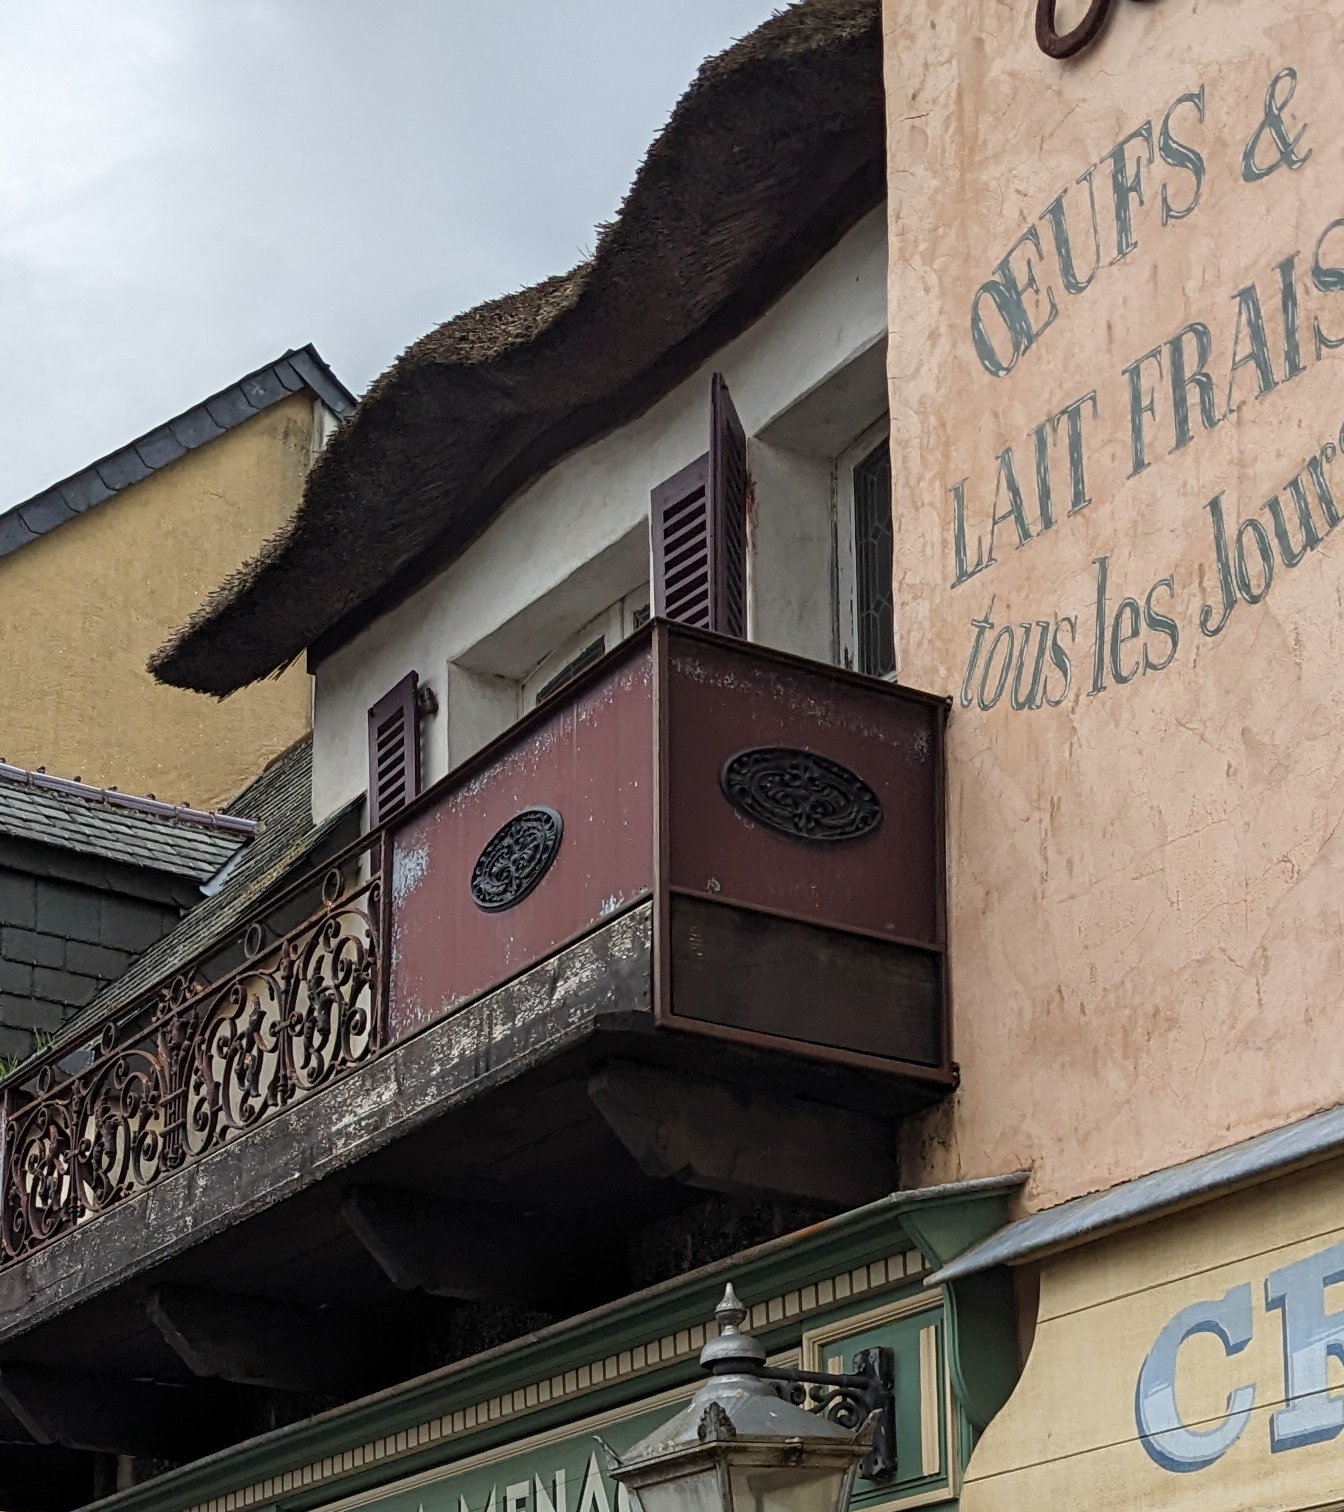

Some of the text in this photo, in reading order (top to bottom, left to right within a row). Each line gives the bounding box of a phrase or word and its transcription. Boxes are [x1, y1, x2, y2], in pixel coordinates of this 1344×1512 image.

[1241, 66, 1313, 183] &
[948, 389, 1099, 589] LAIT
[959, 594, 1078, 711] tous
[1088, 555, 1180, 698] les
